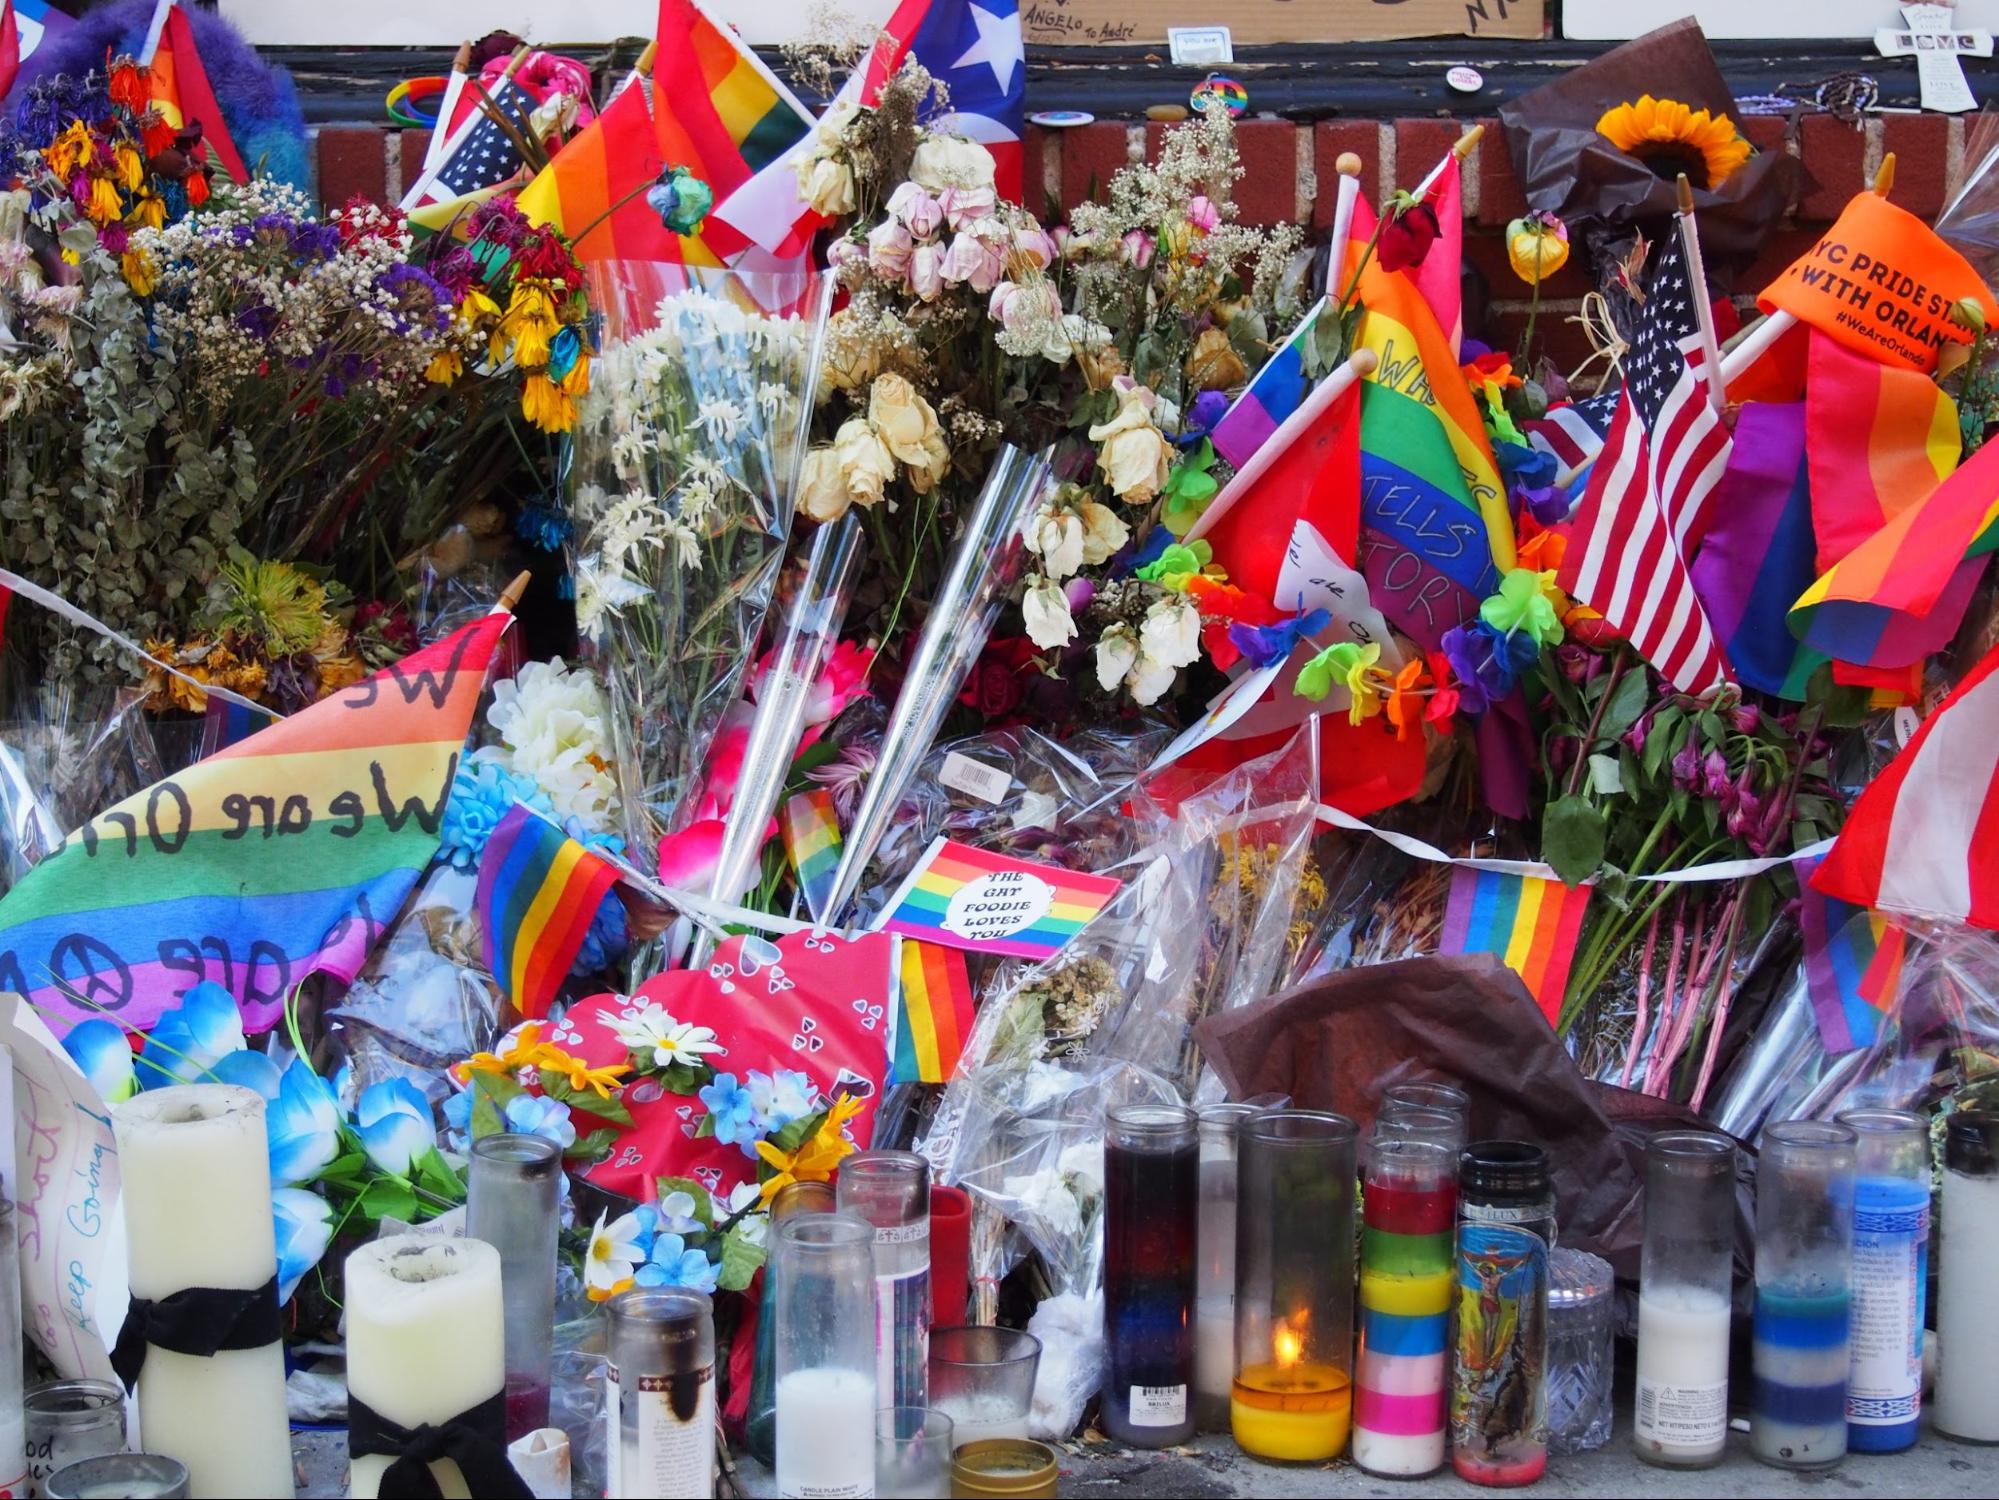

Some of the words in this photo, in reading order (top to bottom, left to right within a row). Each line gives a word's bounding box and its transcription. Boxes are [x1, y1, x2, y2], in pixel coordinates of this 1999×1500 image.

[1024, 5, 1083, 30] ANGELO
[1810, 240, 1848, 264] YC
[1850, 253, 1928, 307] PRIDE
[1801, 265, 1872, 310] WITH
[1876, 301, 1966, 349] ORLAN
[1836, 311, 1926, 365] #WeAreOrlando
[1363, 475, 1477, 558] TELLS
[987, 872, 1024, 882] THE
[983, 887, 1023, 897] GAY
[963, 901, 1031, 913] FOODIE
[963, 915, 1023, 927] LOVES
[969, 929, 1008, 940] YOU
[1855, 1240, 1880, 1249] CION
[65, 1258, 97, 1338] Keep
